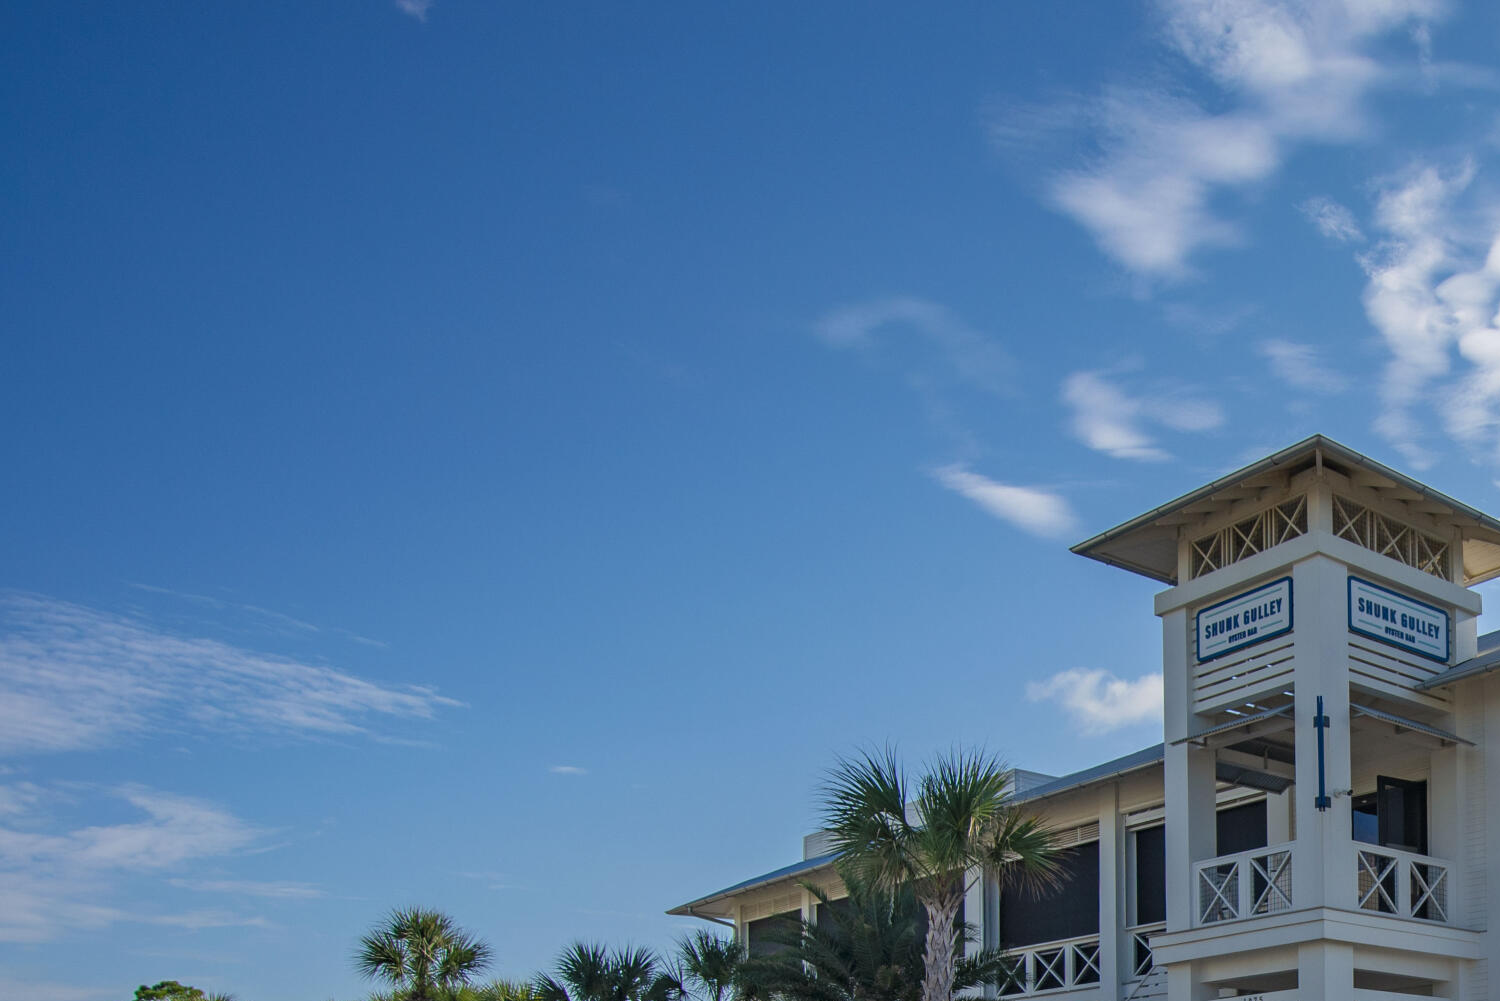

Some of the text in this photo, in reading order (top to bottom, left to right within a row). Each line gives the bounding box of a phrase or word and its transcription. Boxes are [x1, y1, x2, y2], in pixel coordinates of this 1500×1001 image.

[1205, 598, 1282, 639] SHUNK GULLEY
[1358, 597, 1440, 639] SHUNK GULLEY
